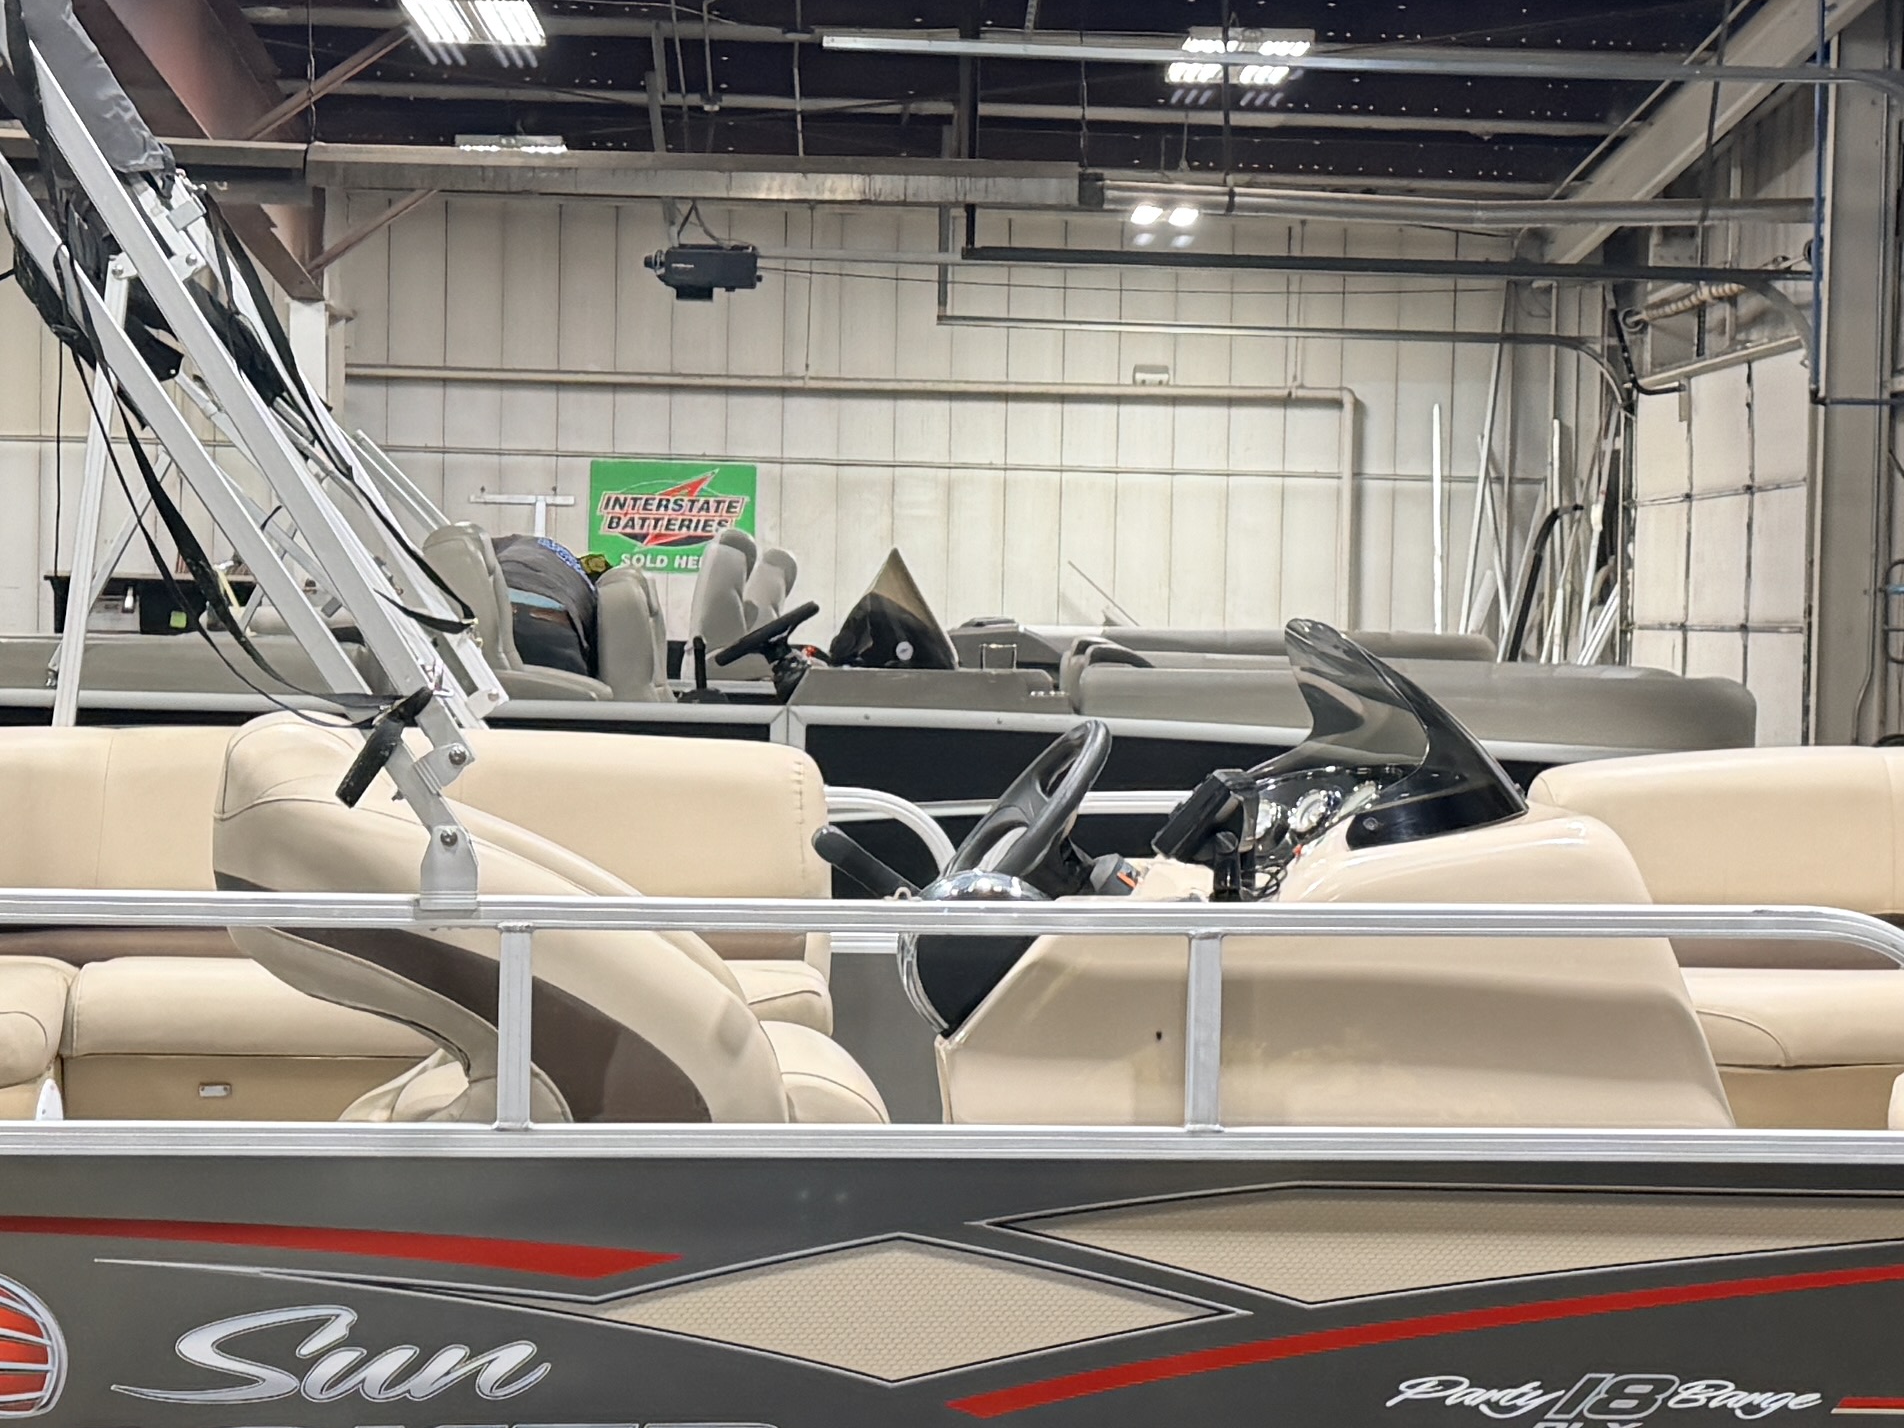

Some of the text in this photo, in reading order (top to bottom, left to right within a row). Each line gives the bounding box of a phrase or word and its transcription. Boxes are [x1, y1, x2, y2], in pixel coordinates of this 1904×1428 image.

[604, 496, 740, 514] INTERSTATE
[607, 516, 730, 533] BATTERIES
[620, 553, 704, 570] SOLD HE
[111, 1304, 553, 1404] Sun
[1385, 1372, 1823, 1420] Party 18 Barge
